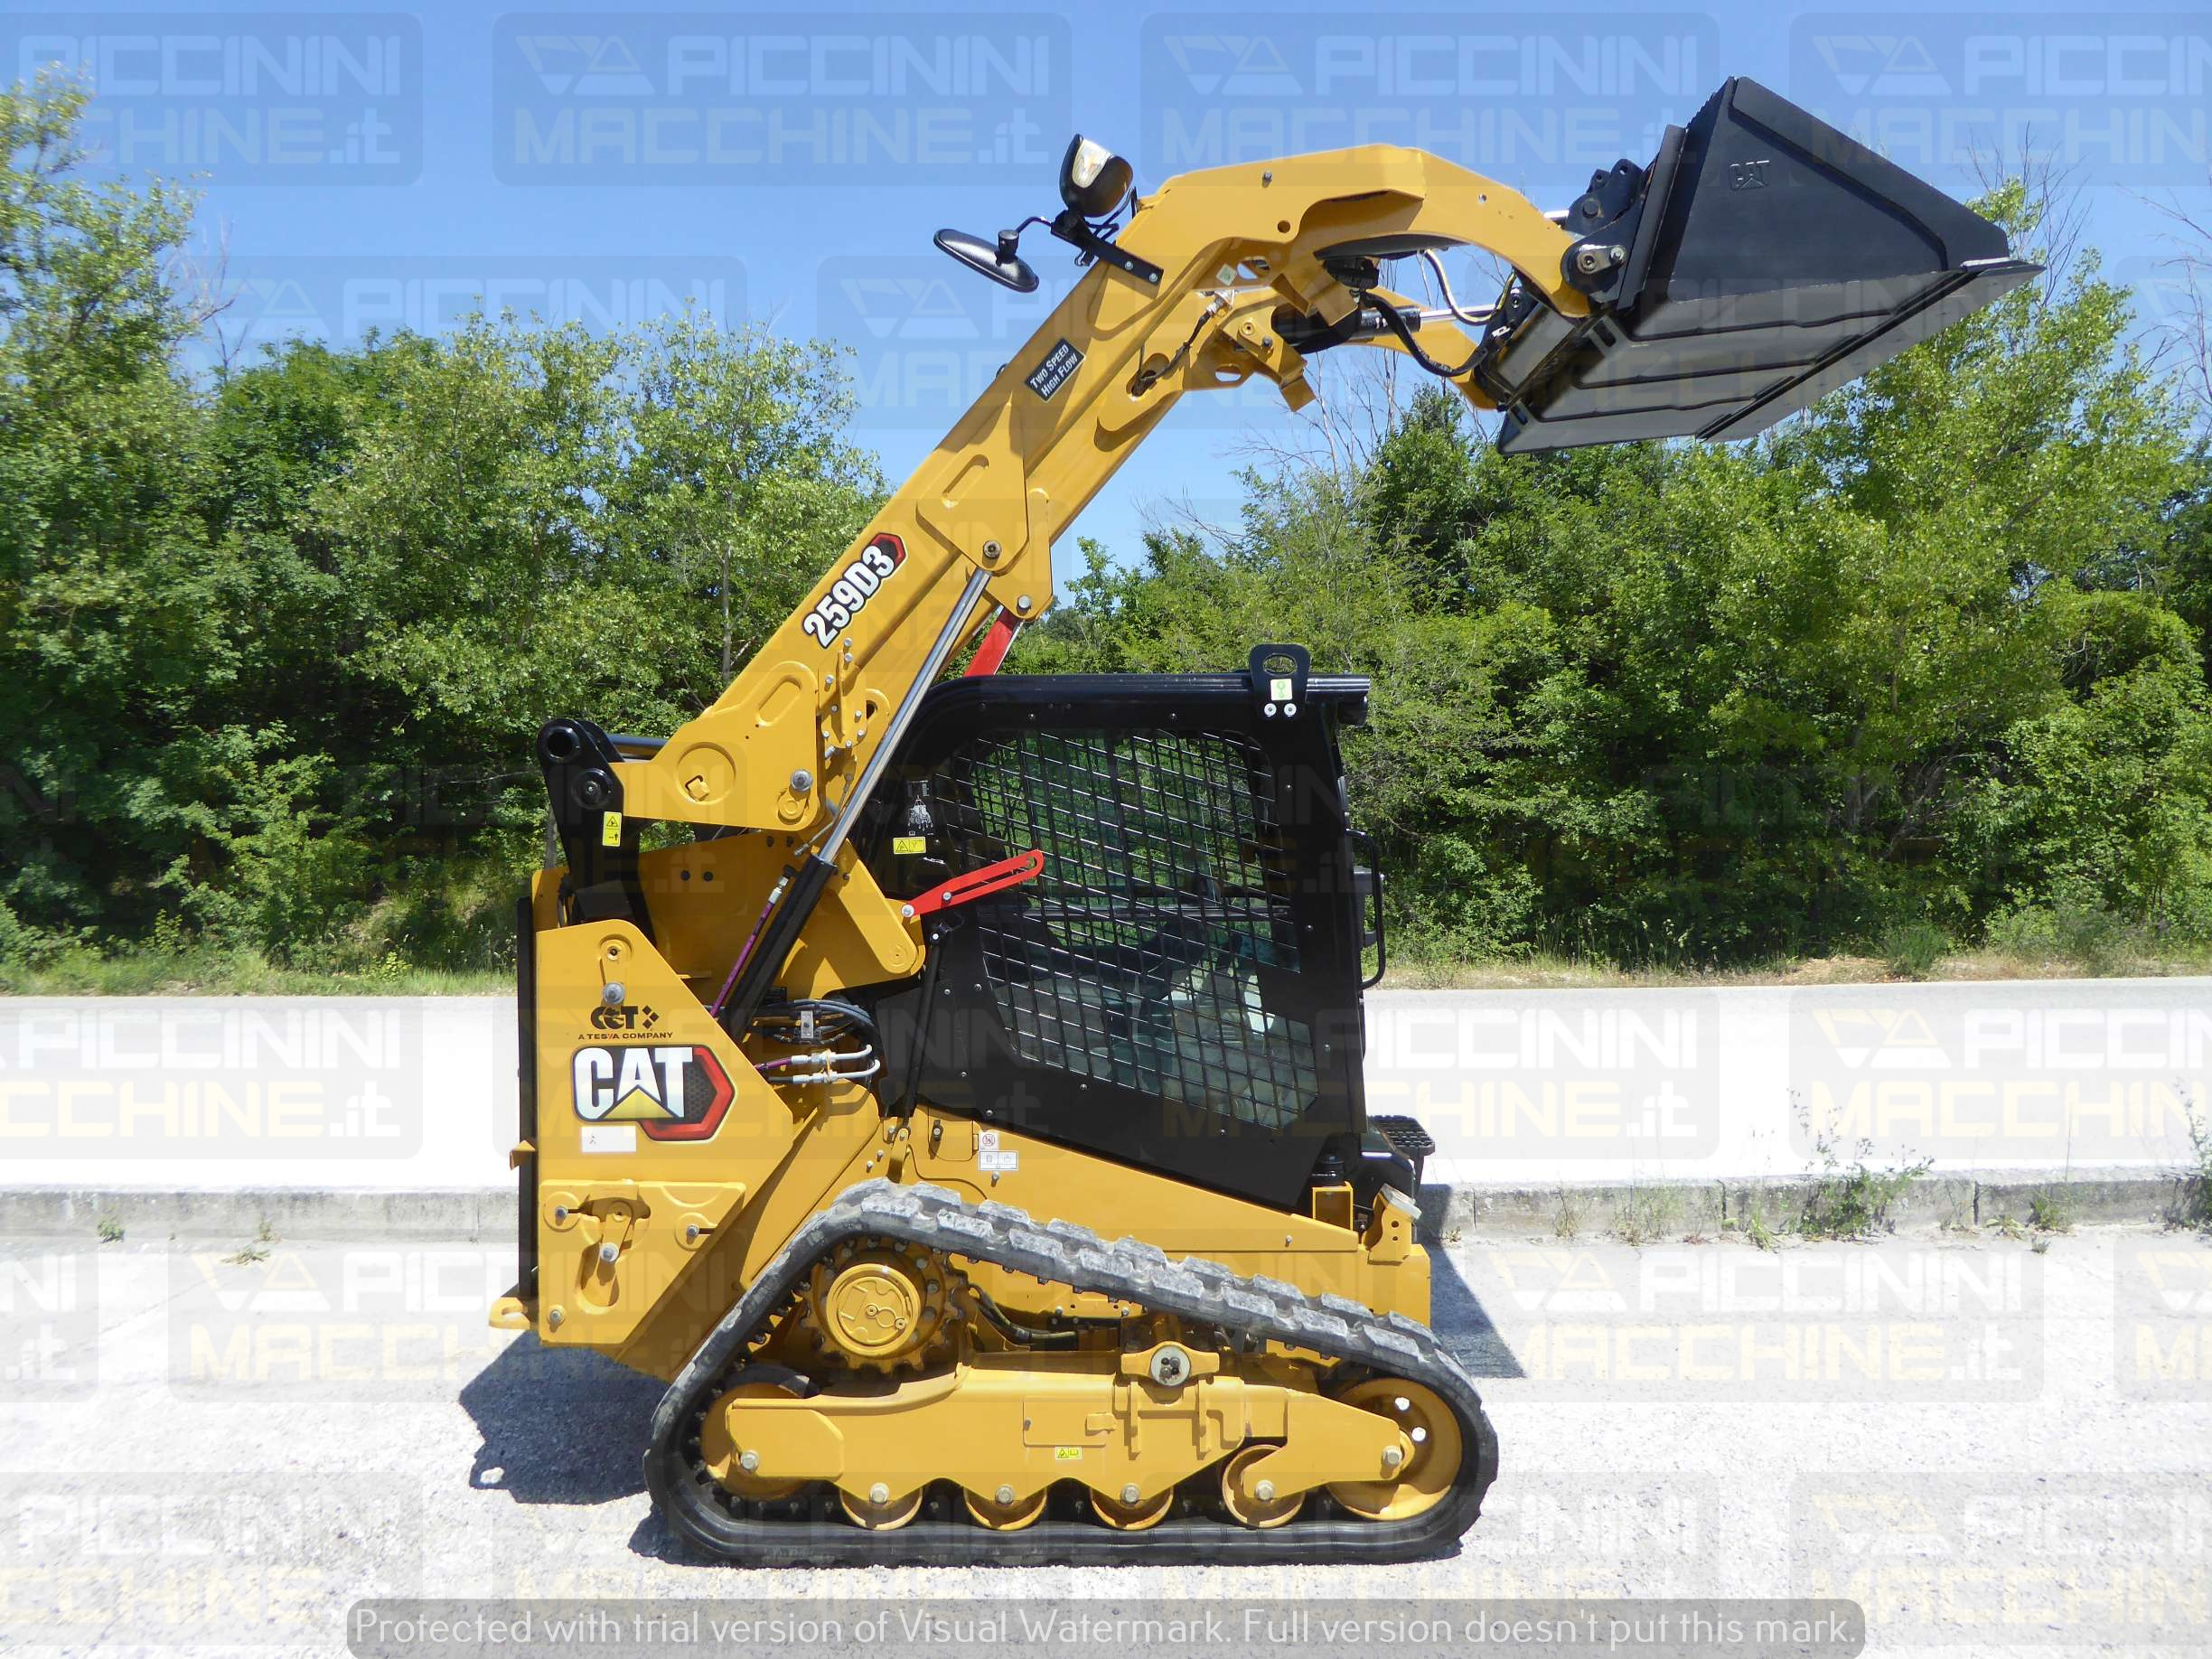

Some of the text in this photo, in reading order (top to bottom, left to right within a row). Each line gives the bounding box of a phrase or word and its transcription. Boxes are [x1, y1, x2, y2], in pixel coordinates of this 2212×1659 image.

[1729, 160, 1770, 192] CAT
[1030, 343, 1069, 389] TWO SPEED
[1041, 352, 1079, 398] HIGH FLOW
[803, 545, 895, 648] 259D3
[574, 1046, 694, 1120] CAT
